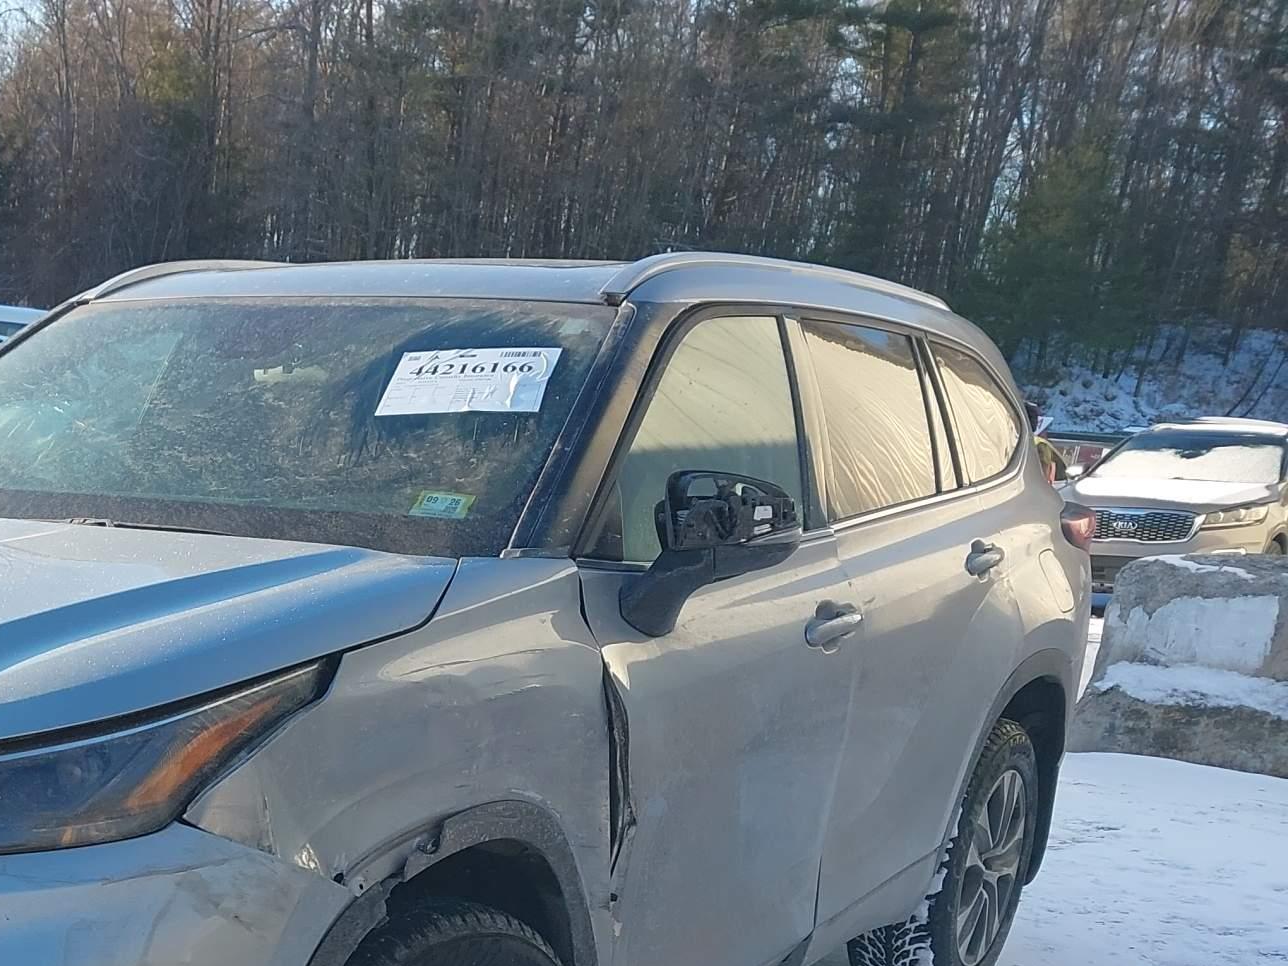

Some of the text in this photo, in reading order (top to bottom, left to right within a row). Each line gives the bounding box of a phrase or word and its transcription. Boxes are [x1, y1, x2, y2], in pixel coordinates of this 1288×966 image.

[409, 361, 535, 376] 44216166
[426, 495, 439, 504] 09
[1116, 520, 1134, 530] KIA
